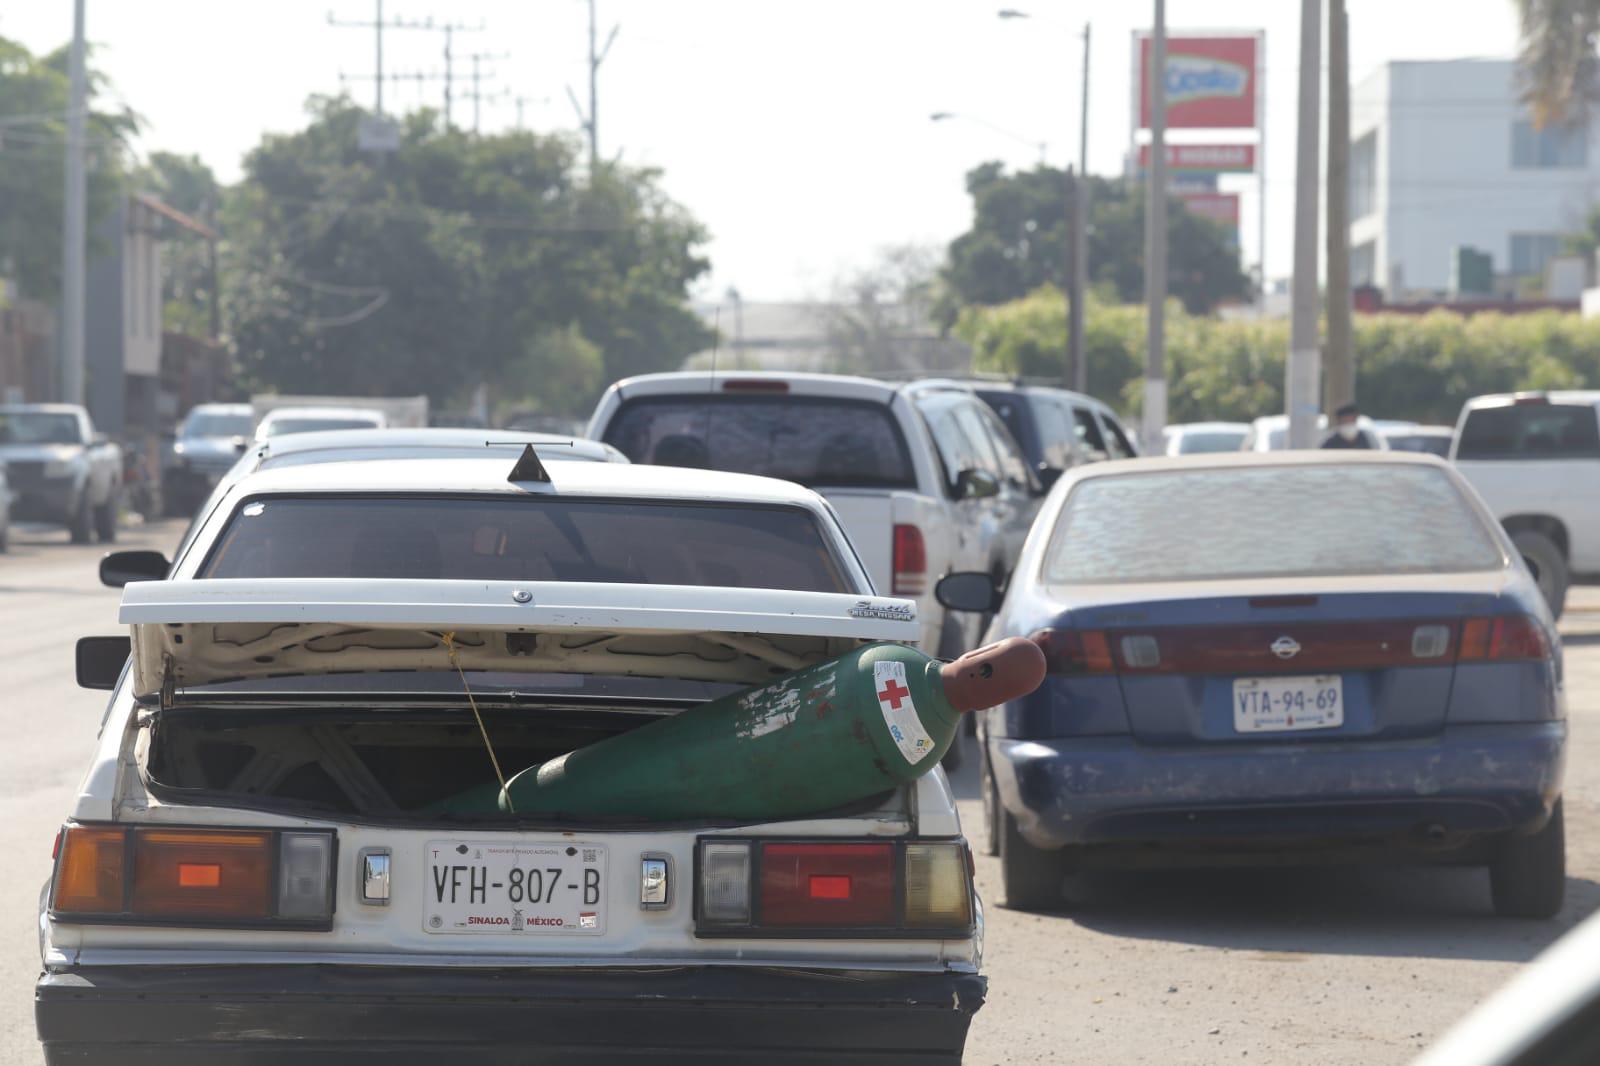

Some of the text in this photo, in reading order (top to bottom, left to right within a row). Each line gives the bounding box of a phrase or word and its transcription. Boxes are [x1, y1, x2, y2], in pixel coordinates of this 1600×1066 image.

[1238, 688, 1338, 714] VTA-94-69
[432, 865, 600, 905] VFH-807-B
[468, 915, 563, 926] SINALOA MÉXICO
